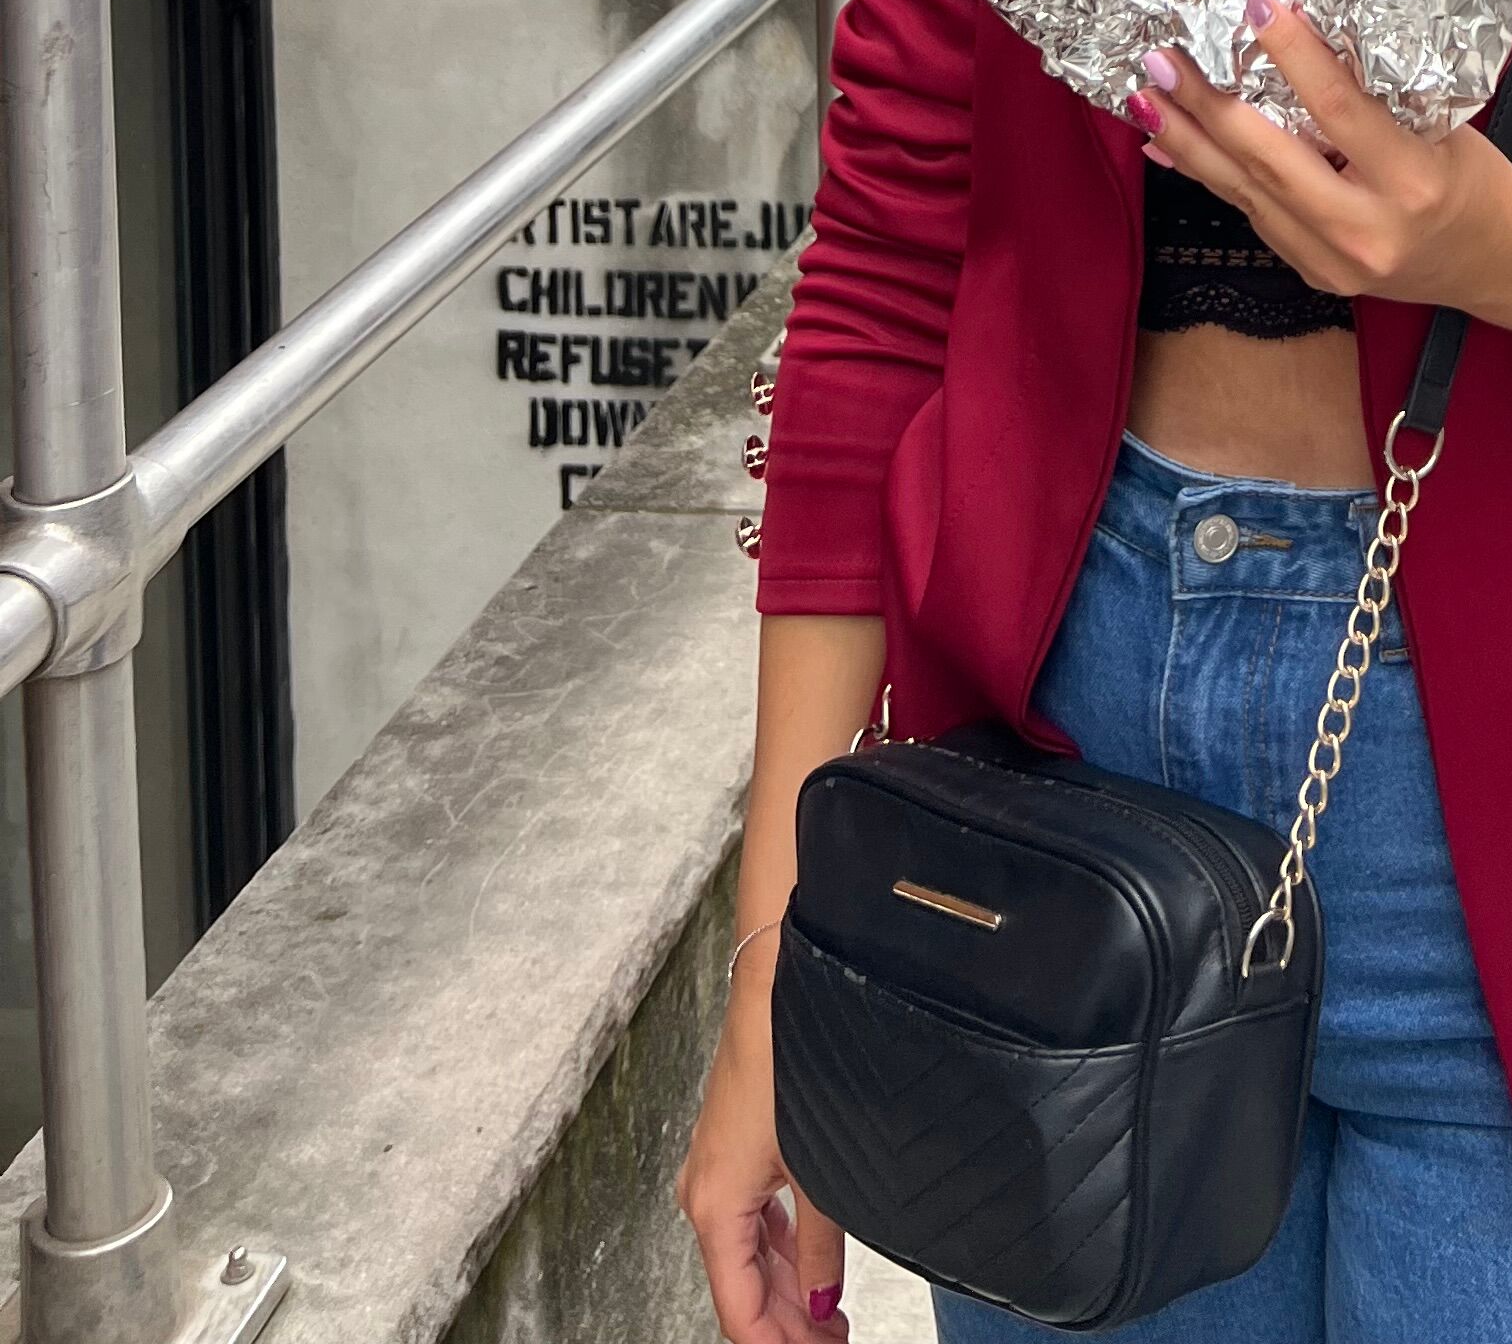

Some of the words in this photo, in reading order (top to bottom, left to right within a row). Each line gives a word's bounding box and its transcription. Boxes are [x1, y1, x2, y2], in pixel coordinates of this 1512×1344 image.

[648, 199, 737, 249] ARE
[499, 267, 726, 320] CHILDREN
[497, 329, 679, 387] REFUSE
